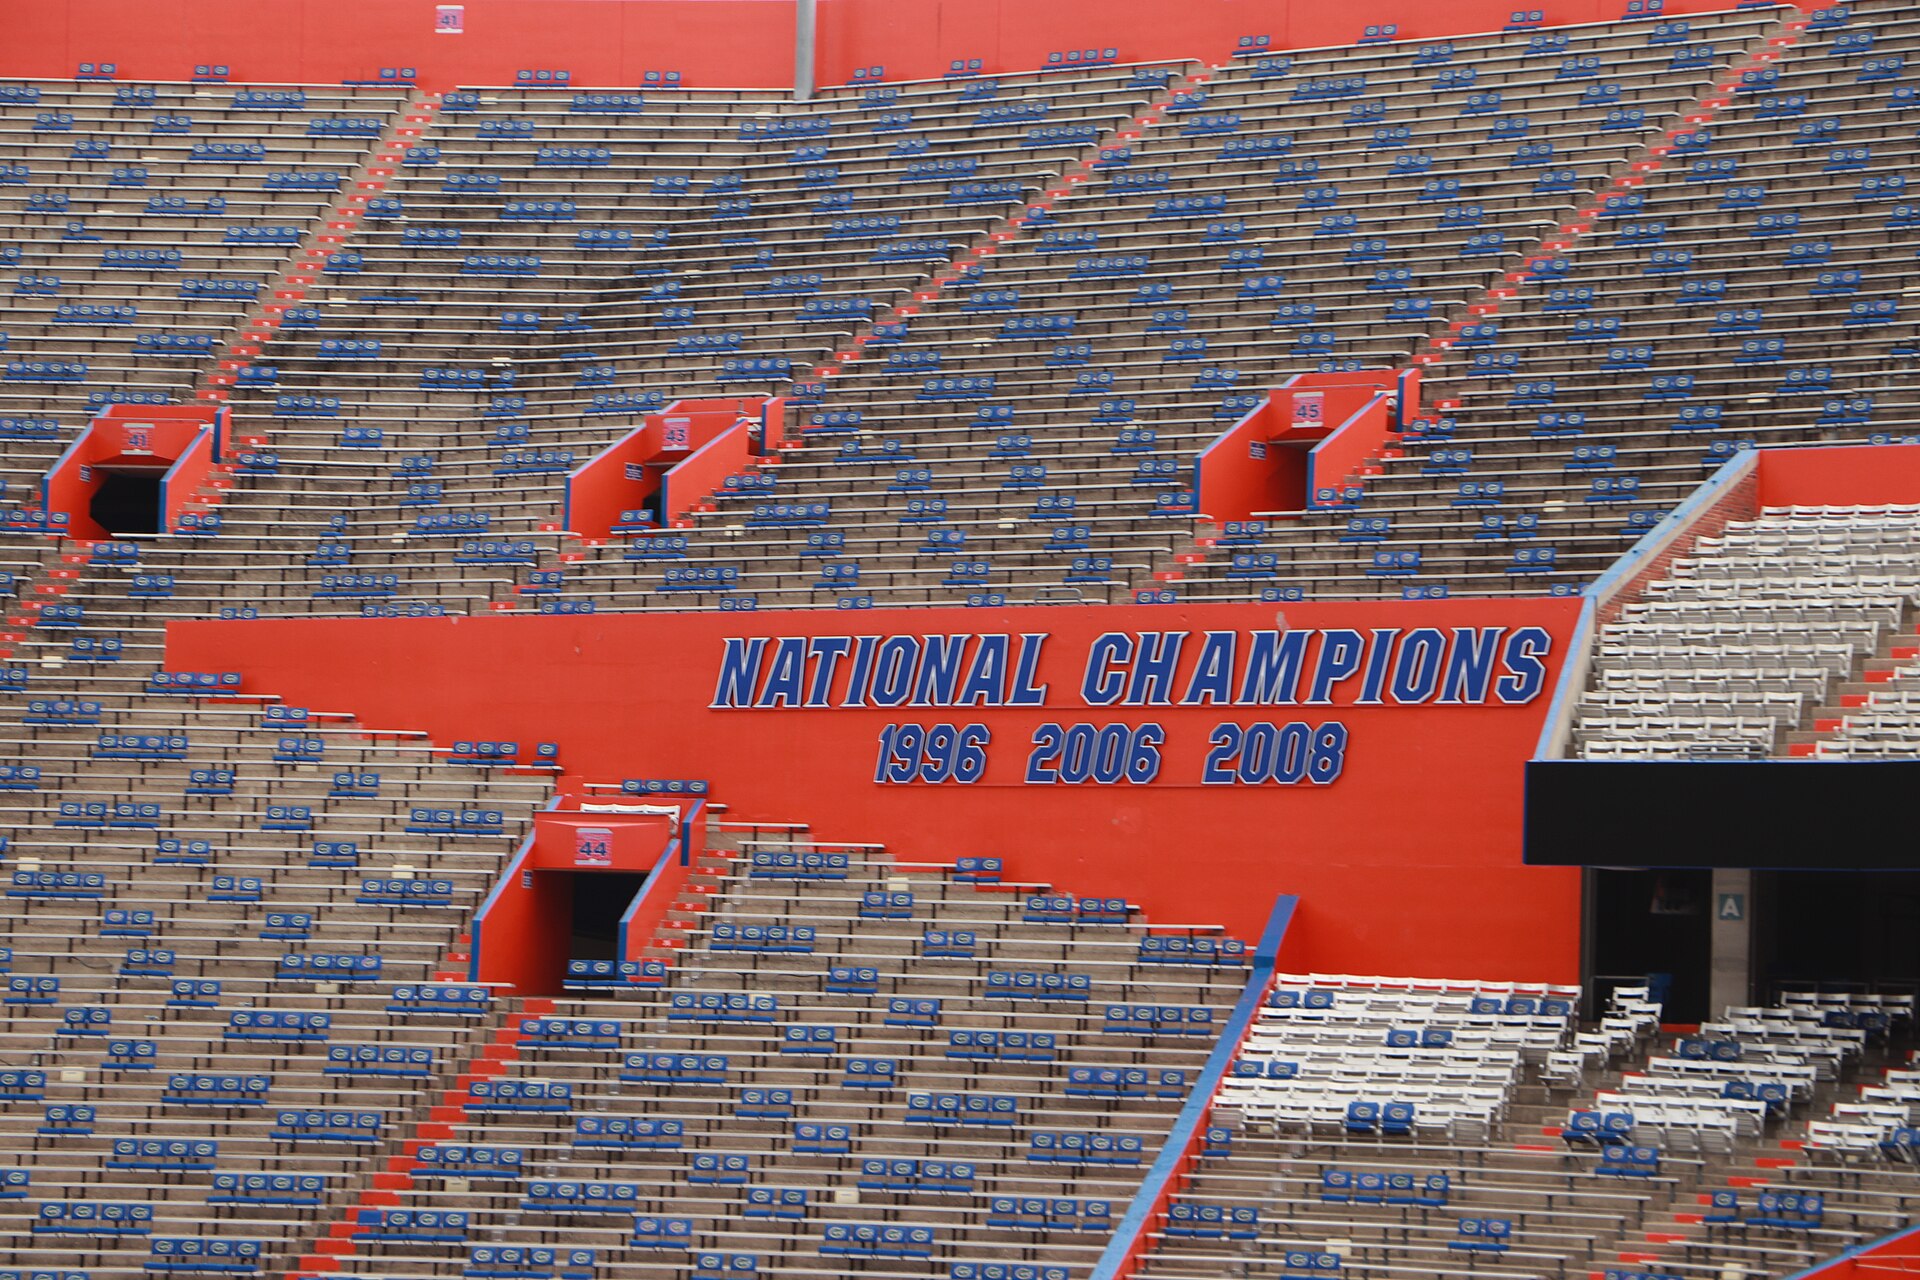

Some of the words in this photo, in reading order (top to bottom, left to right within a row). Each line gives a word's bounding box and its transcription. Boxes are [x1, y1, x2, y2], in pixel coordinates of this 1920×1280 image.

[440, 15, 457, 26] 41
[1296, 404, 1319, 418] 45
[128, 434, 147, 447] 41
[666, 428, 686, 442] 43
[707, 633, 1050, 708] NATIONAL
[1080, 627, 1552, 706] CHAMPIONS
[873, 723, 991, 785] 1996
[1024, 722, 1166, 785] 2006
[1201, 722, 1348, 785] 2008
[579, 841, 607, 856] 44
[1721, 897, 1741, 917] A
